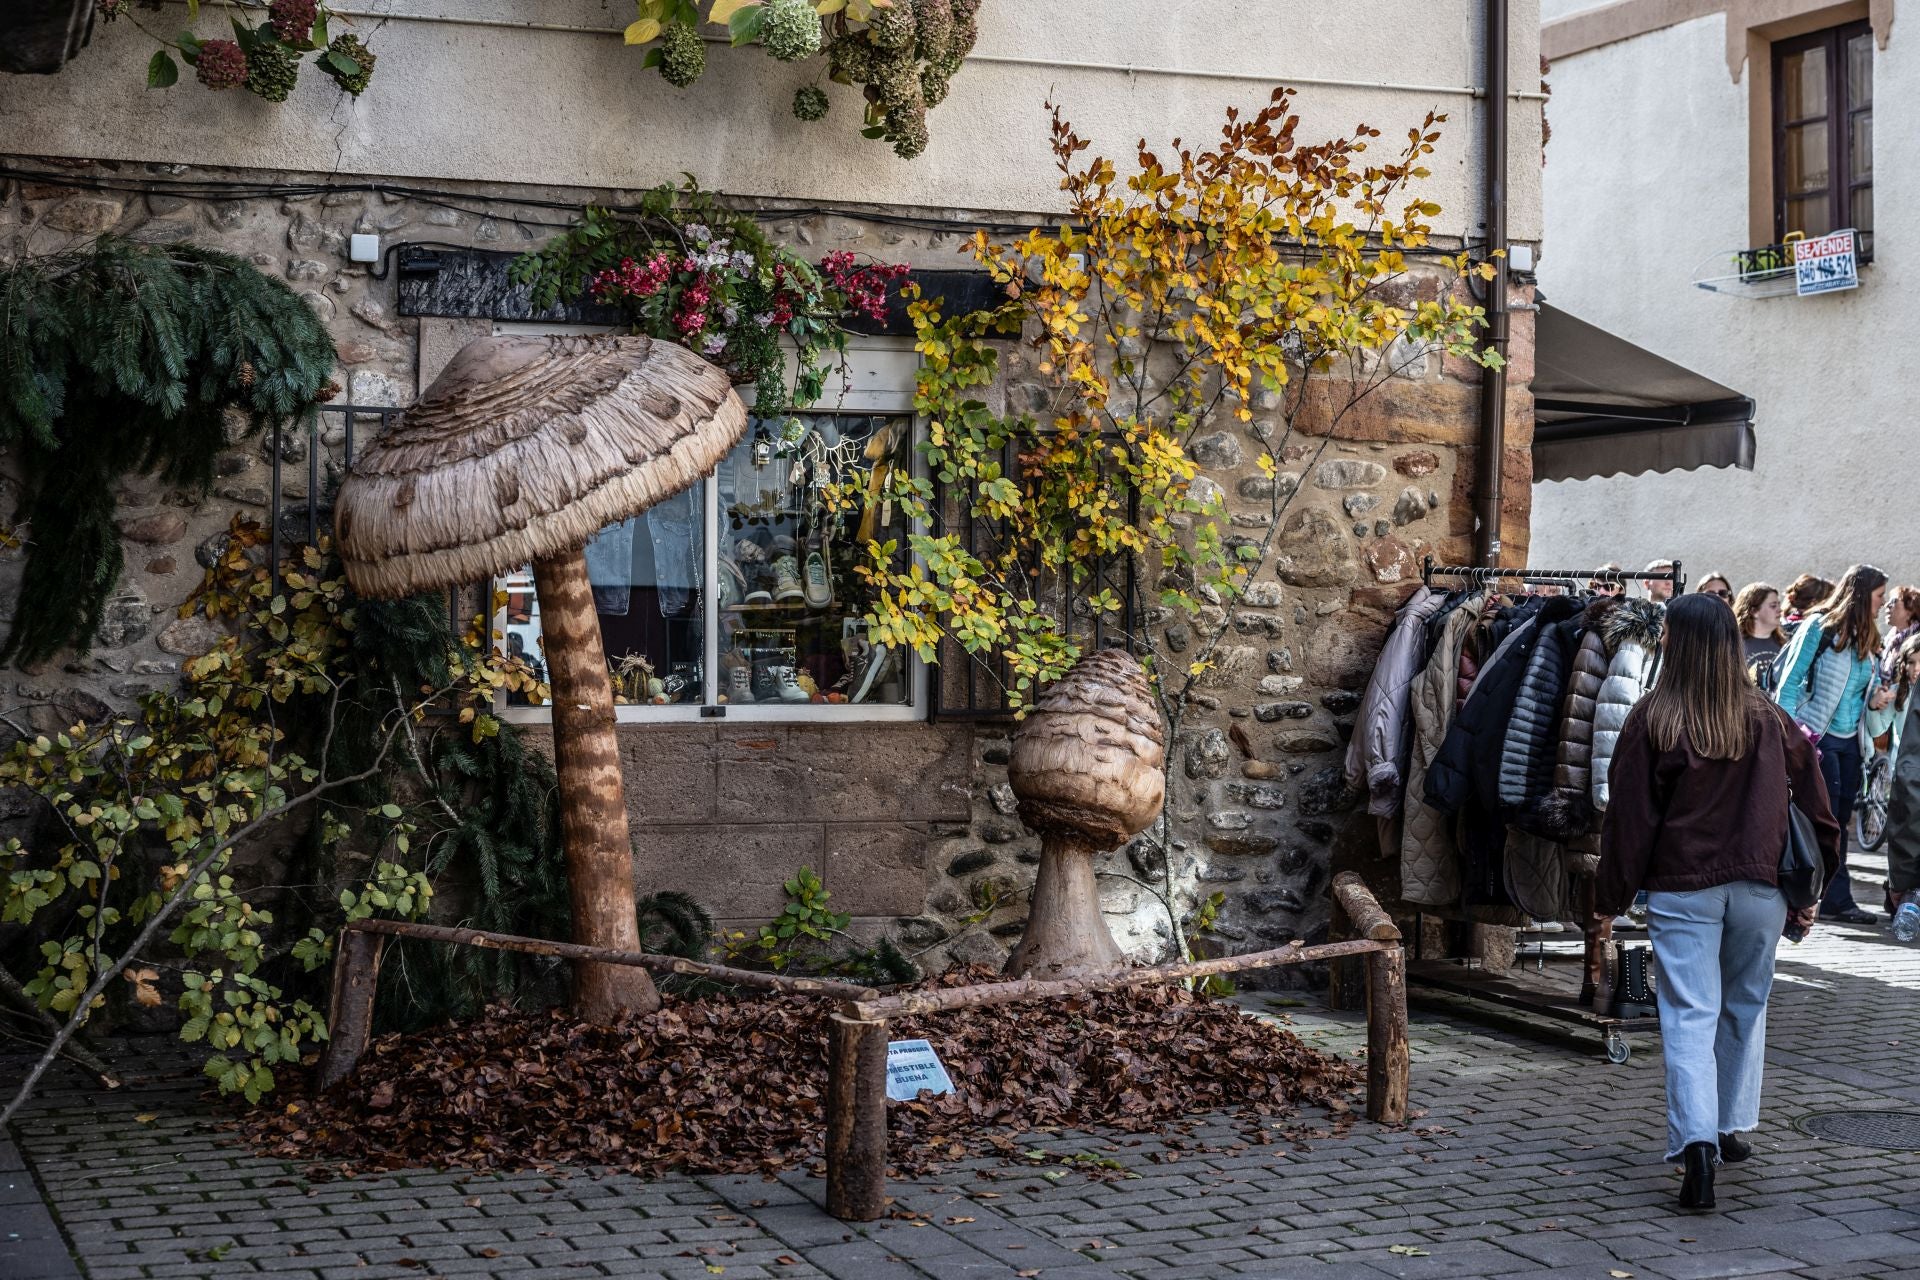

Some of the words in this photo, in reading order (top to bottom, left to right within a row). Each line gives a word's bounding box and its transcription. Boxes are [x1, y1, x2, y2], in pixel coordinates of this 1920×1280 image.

[1797, 243, 1811, 260] SE
[1812, 237, 1851, 257] VENDE
[1837, 254, 1854, 276] 521
[887, 1062, 936, 1074] MESTIBLE
[895, 1073, 928, 1084] BUENA
